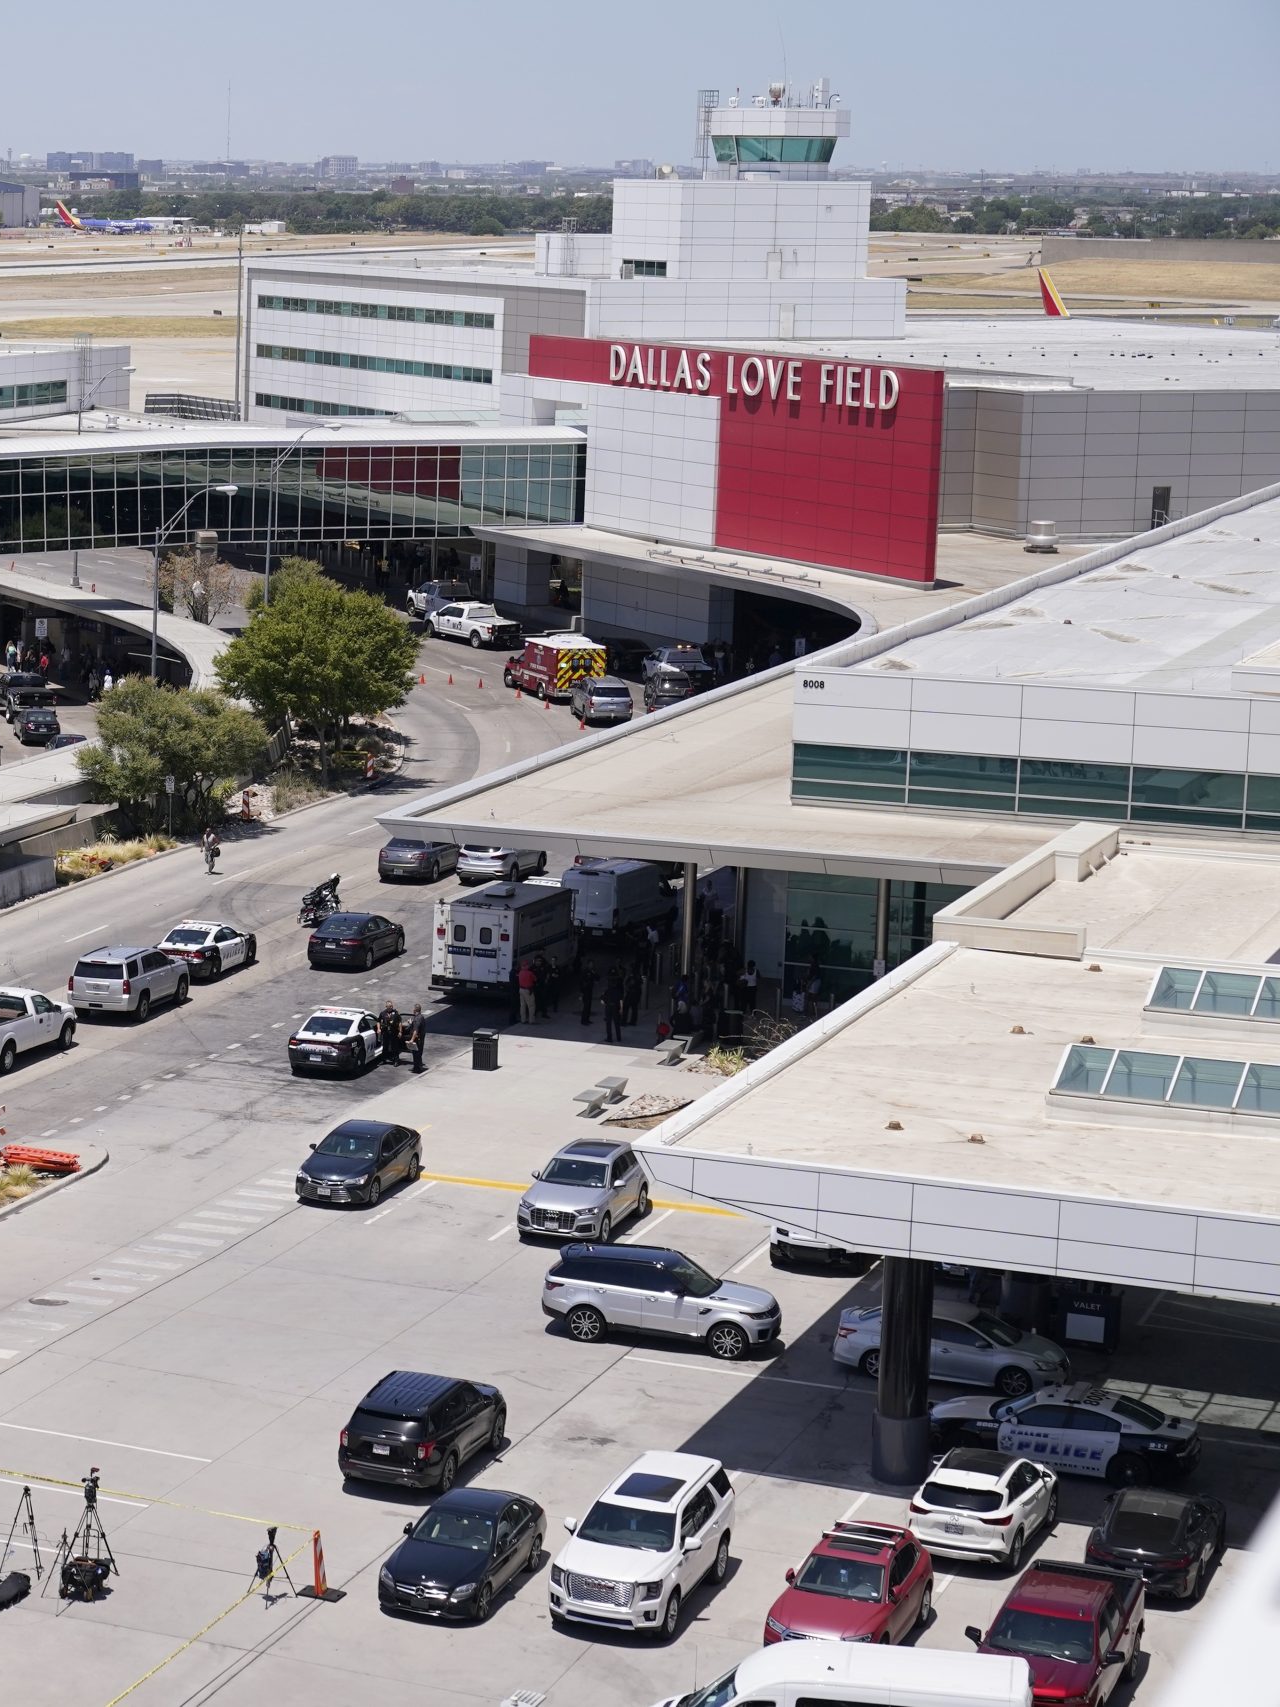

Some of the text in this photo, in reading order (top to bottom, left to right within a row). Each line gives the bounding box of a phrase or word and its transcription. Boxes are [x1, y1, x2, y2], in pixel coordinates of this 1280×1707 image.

[610, 345, 900, 410] DALLAS LOVE FIELD
[803, 680, 825, 689] 8008
[1073, 1301, 1101, 1311] VALET
[976, 1421, 999, 1429] 8002
[1017, 1439, 1104, 1461] POLICE
